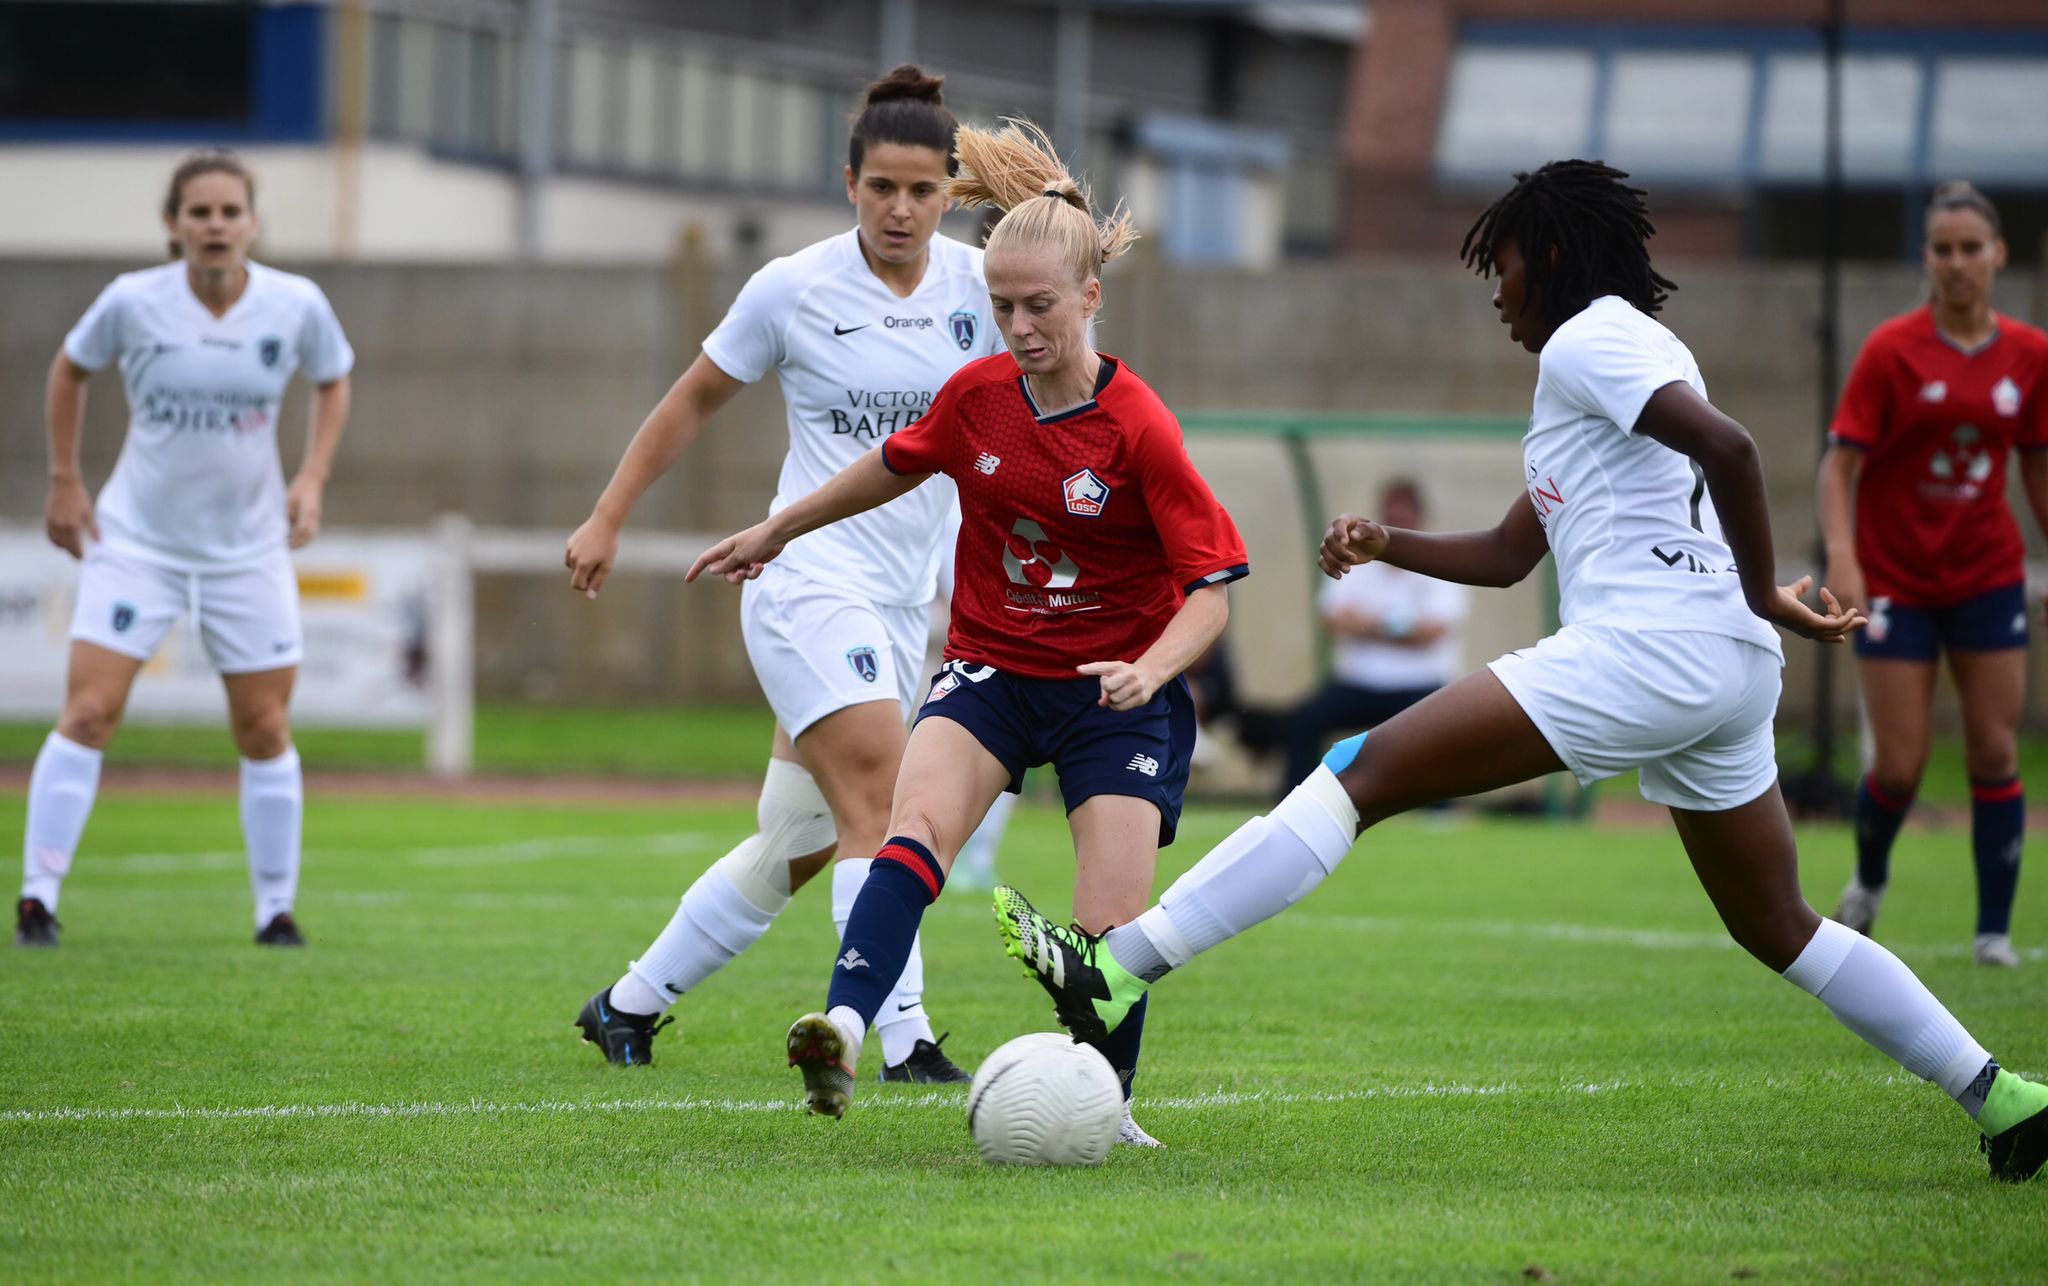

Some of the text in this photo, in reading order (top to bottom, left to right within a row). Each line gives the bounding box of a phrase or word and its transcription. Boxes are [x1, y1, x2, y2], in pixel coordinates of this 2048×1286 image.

[884, 315, 934, 330] Orange
[847, 390, 939, 408] VICTOR
[830, 409, 922, 439] BAHR
[1071, 502, 1097, 513] LOSC
